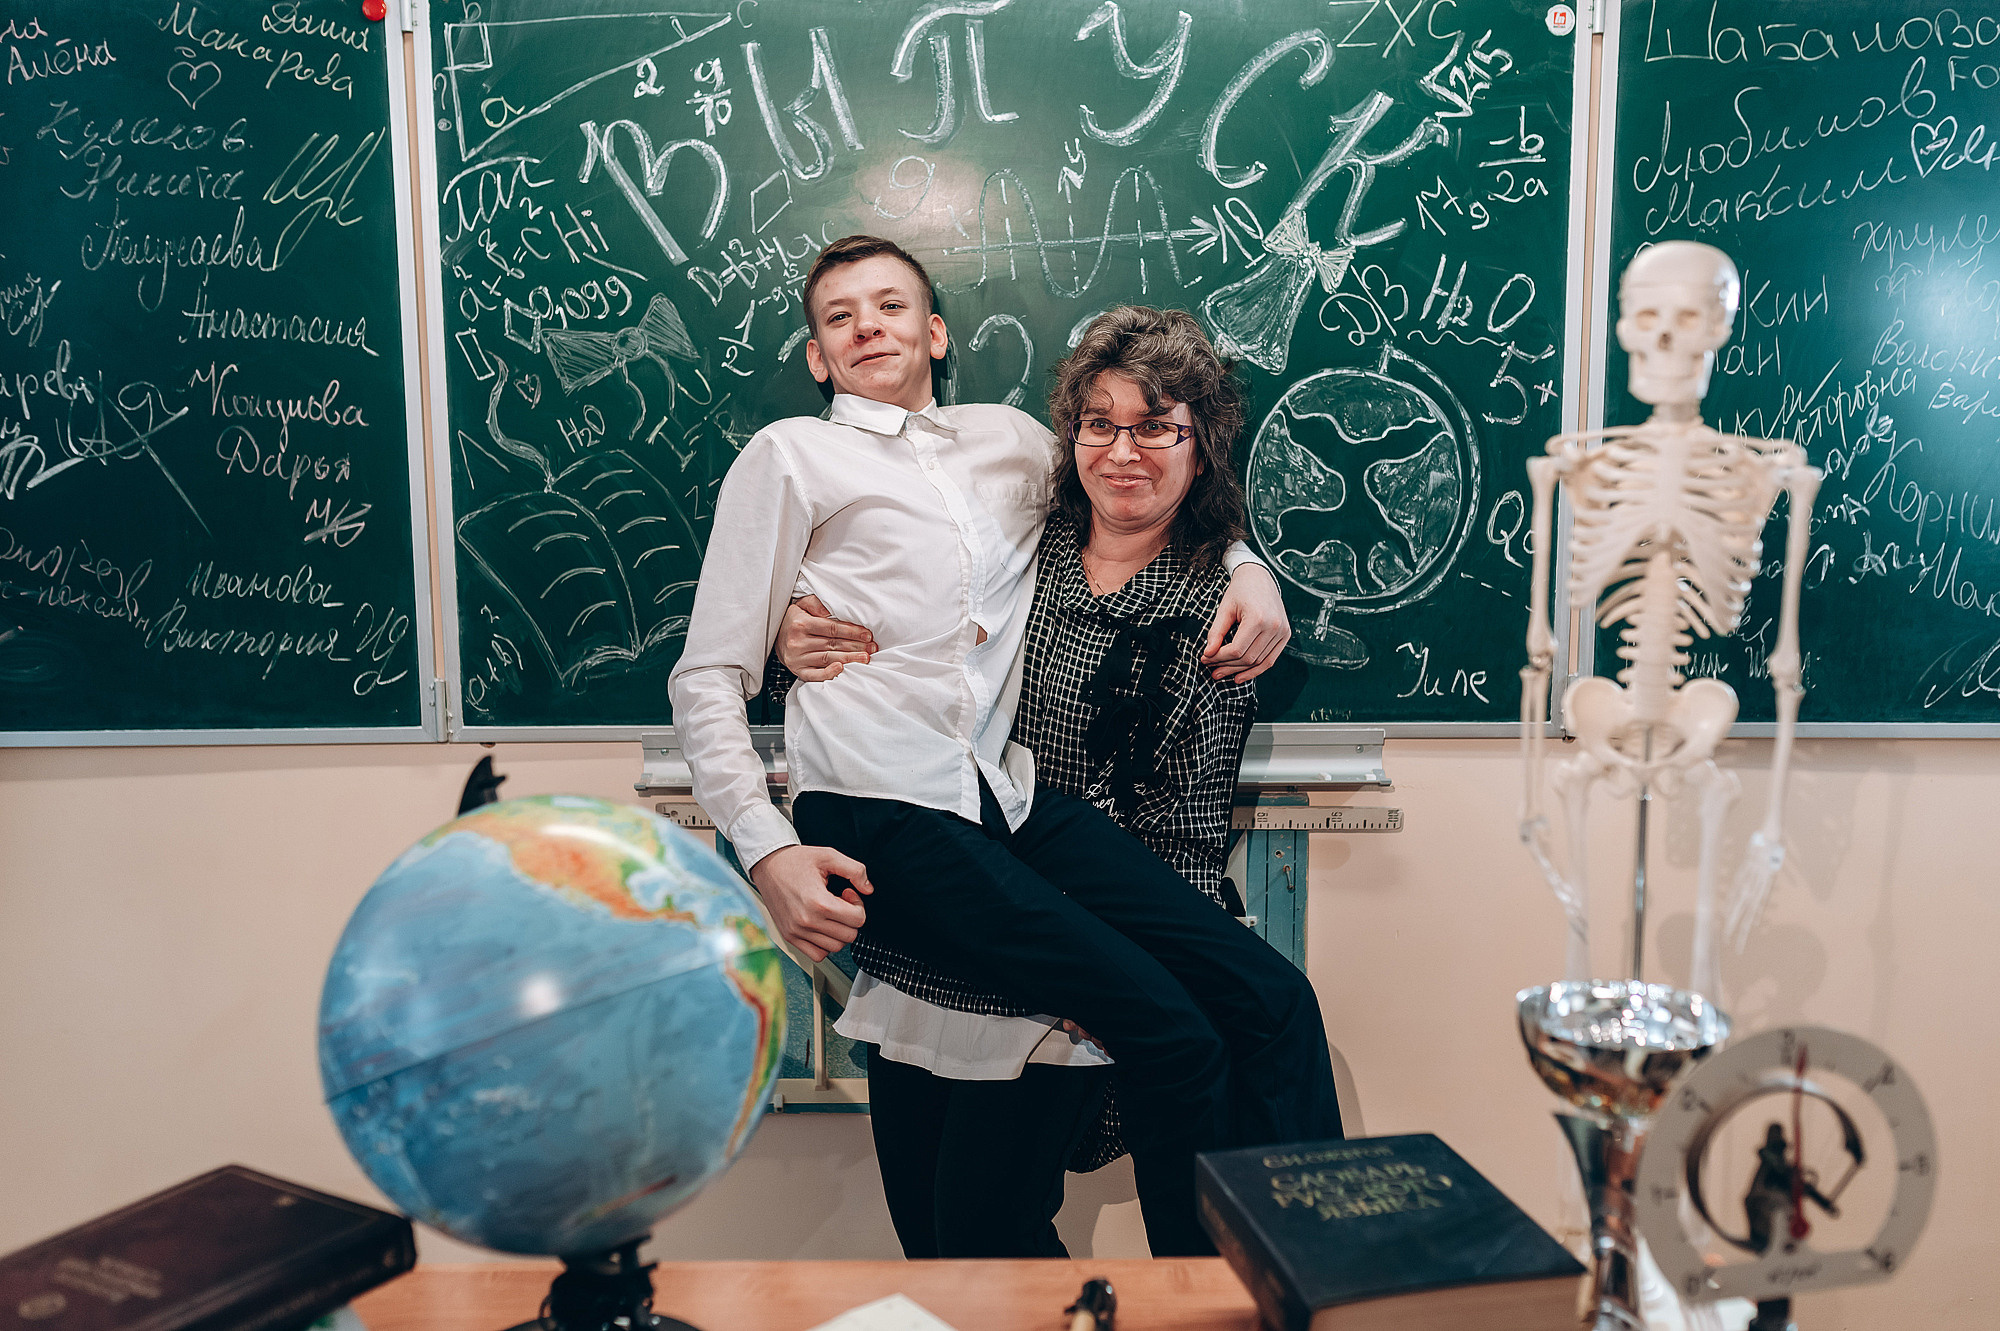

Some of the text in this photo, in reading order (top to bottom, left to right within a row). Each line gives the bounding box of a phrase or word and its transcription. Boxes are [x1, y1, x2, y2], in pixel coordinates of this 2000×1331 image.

[158, 2, 353, 100] Макарова
[178, 282, 380, 356] Анастасия
[186, 560, 344, 610] Иванова
[145, 597, 352, 681] Виктория
